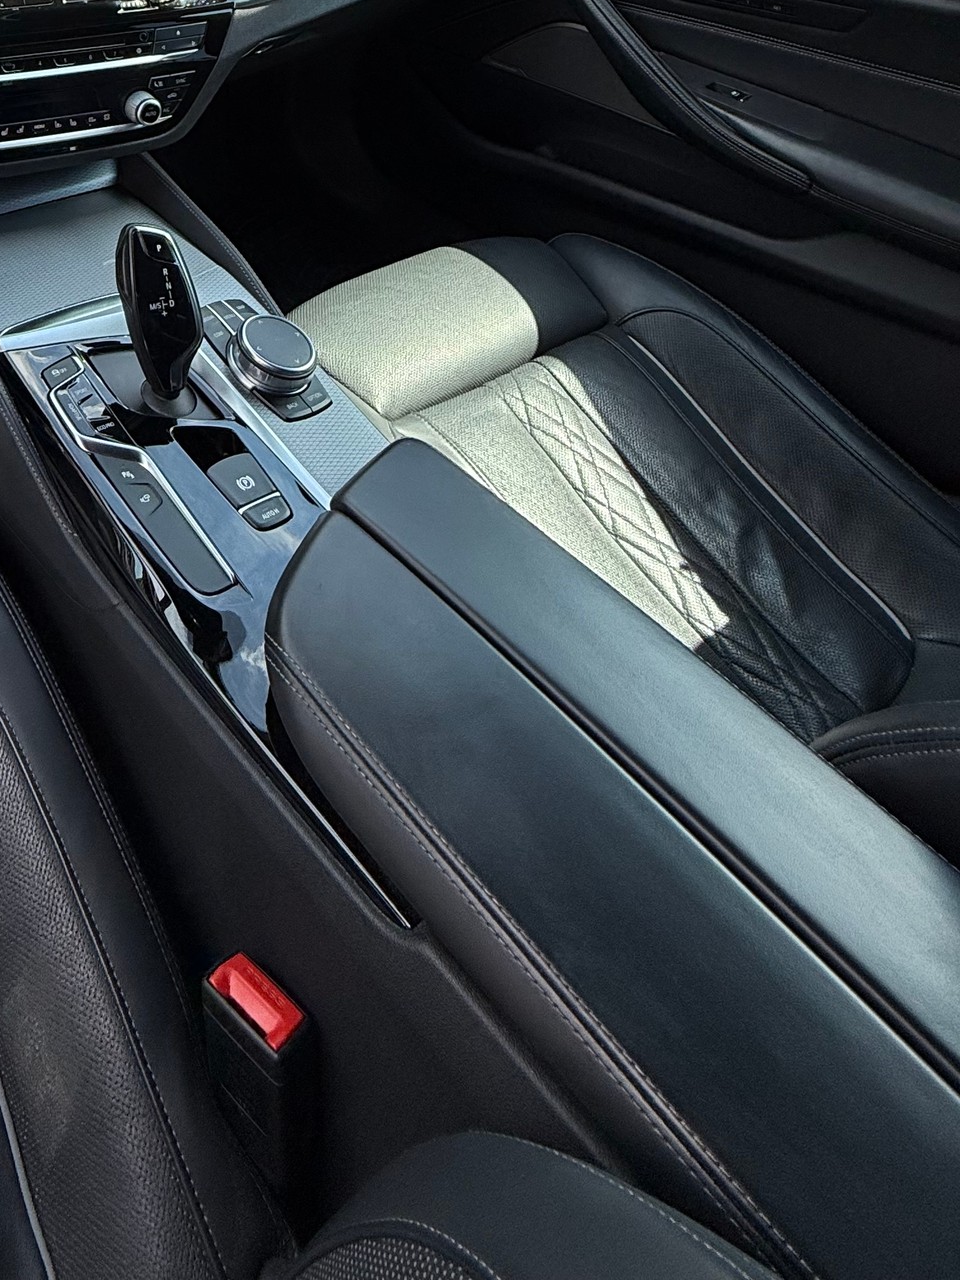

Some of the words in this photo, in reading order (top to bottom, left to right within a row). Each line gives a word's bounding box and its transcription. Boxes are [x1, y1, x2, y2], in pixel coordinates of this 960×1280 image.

[156, 244, 161, 252] P
[166, 282, 172, 290] N
[261, 510, 274, 520] AUTO
